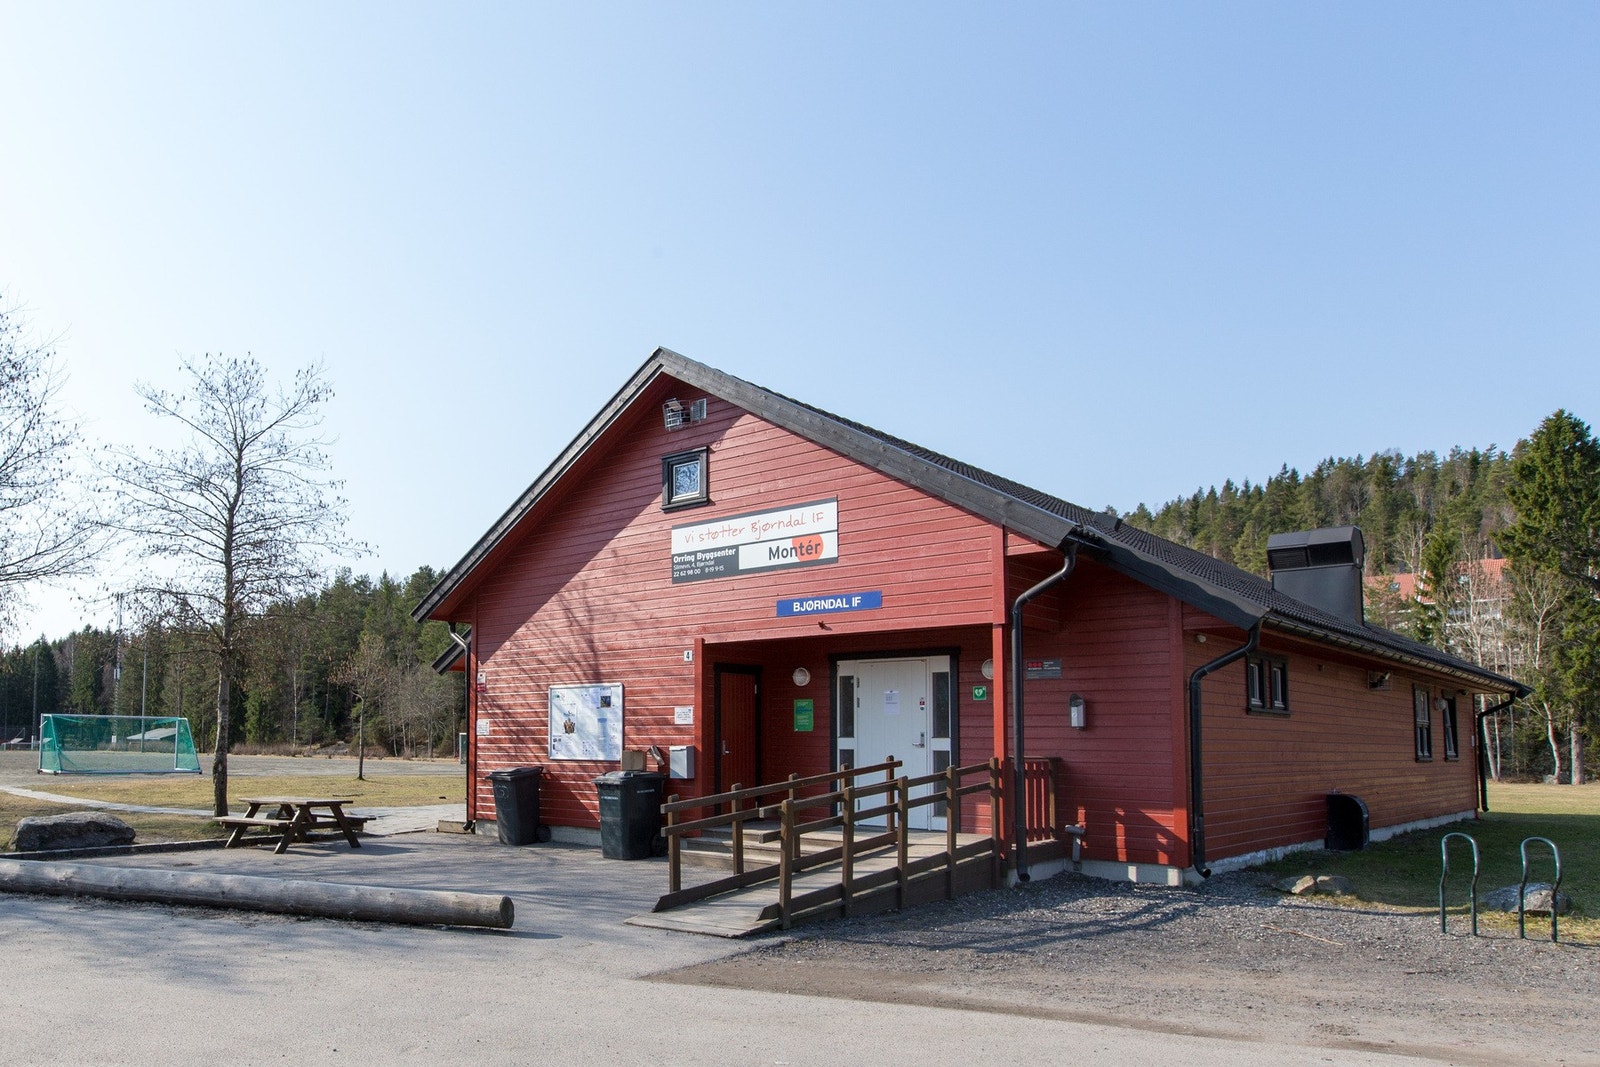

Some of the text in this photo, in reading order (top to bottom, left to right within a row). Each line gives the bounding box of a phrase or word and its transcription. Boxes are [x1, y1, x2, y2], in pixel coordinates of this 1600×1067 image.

[698, 524, 745, 542] støtter
[751, 512, 807, 540] Bjørndal
[811, 511, 824, 523] IF
[673, 548, 736, 563] Orring Byggsenter
[768, 539, 820, 561] Montér
[793, 596, 861, 612] BJØRNDAL IF
[686, 651, 690, 660] 4
